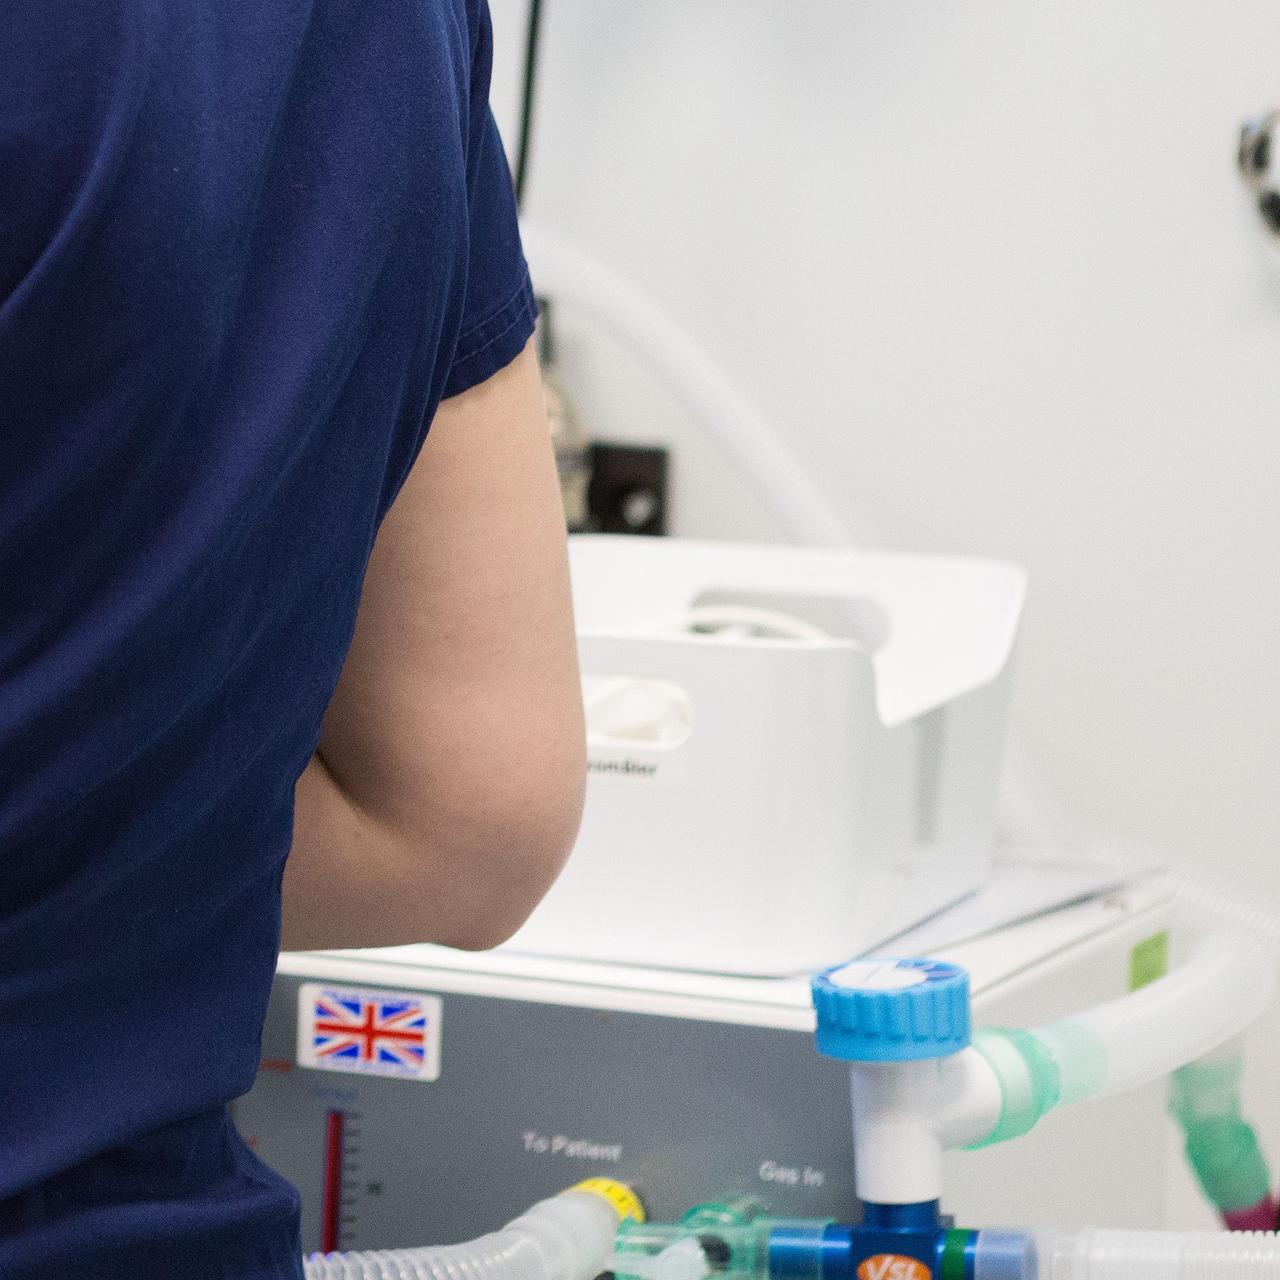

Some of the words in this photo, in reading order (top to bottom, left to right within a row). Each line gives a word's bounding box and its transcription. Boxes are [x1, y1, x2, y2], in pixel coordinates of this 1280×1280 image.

[523, 1131, 550, 1154] To
[551, 1134, 623, 1162] Patient
[758, 1160, 801, 1186] Gas
